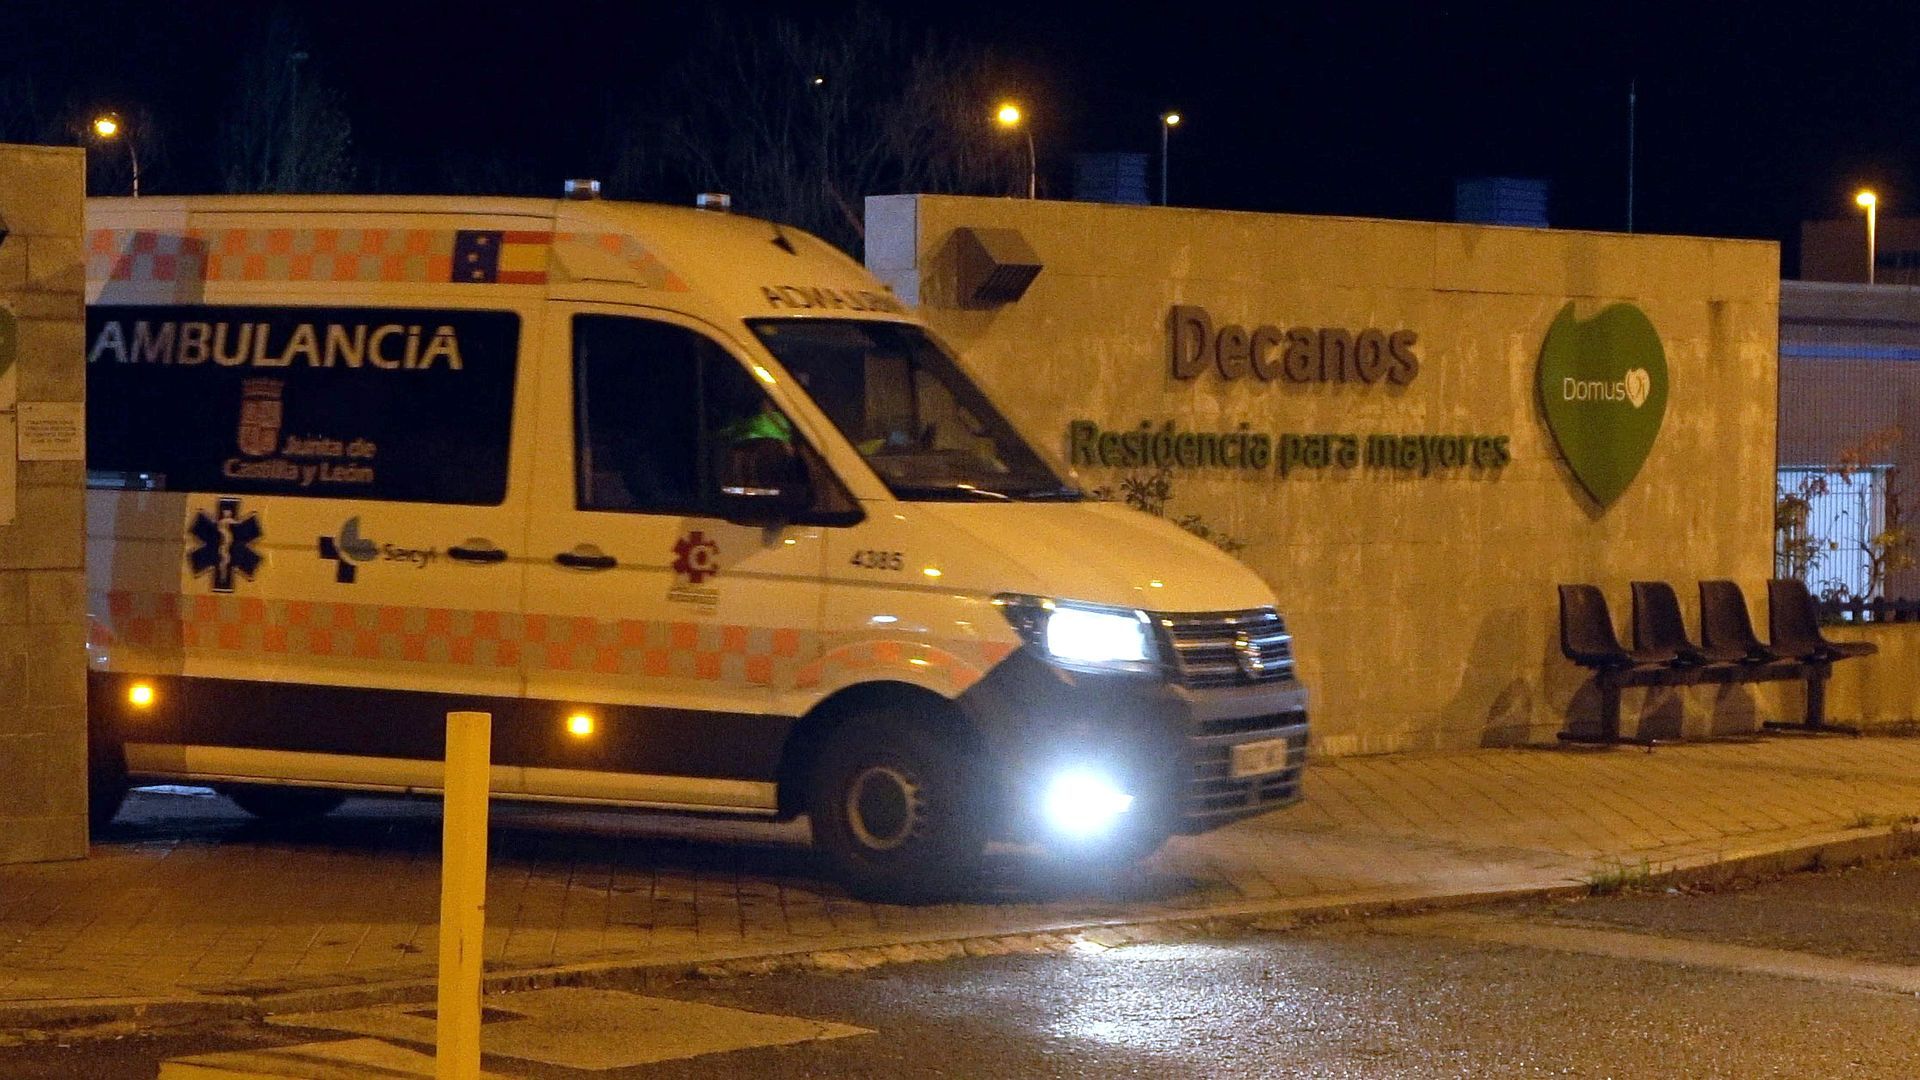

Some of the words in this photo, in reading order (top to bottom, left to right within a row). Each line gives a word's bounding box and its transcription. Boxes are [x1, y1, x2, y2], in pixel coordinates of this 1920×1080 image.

[1168, 305, 1419, 387] Decanos
[346, 437, 377, 458] de
[1070, 420, 1271, 470] Residencia
[1276, 433, 1359, 479] para
[1366, 434, 1511, 478] mayores
[223, 458, 300, 480] Castilla
[301, 465, 317, 486] y
[851, 550, 904, 571] 4385
